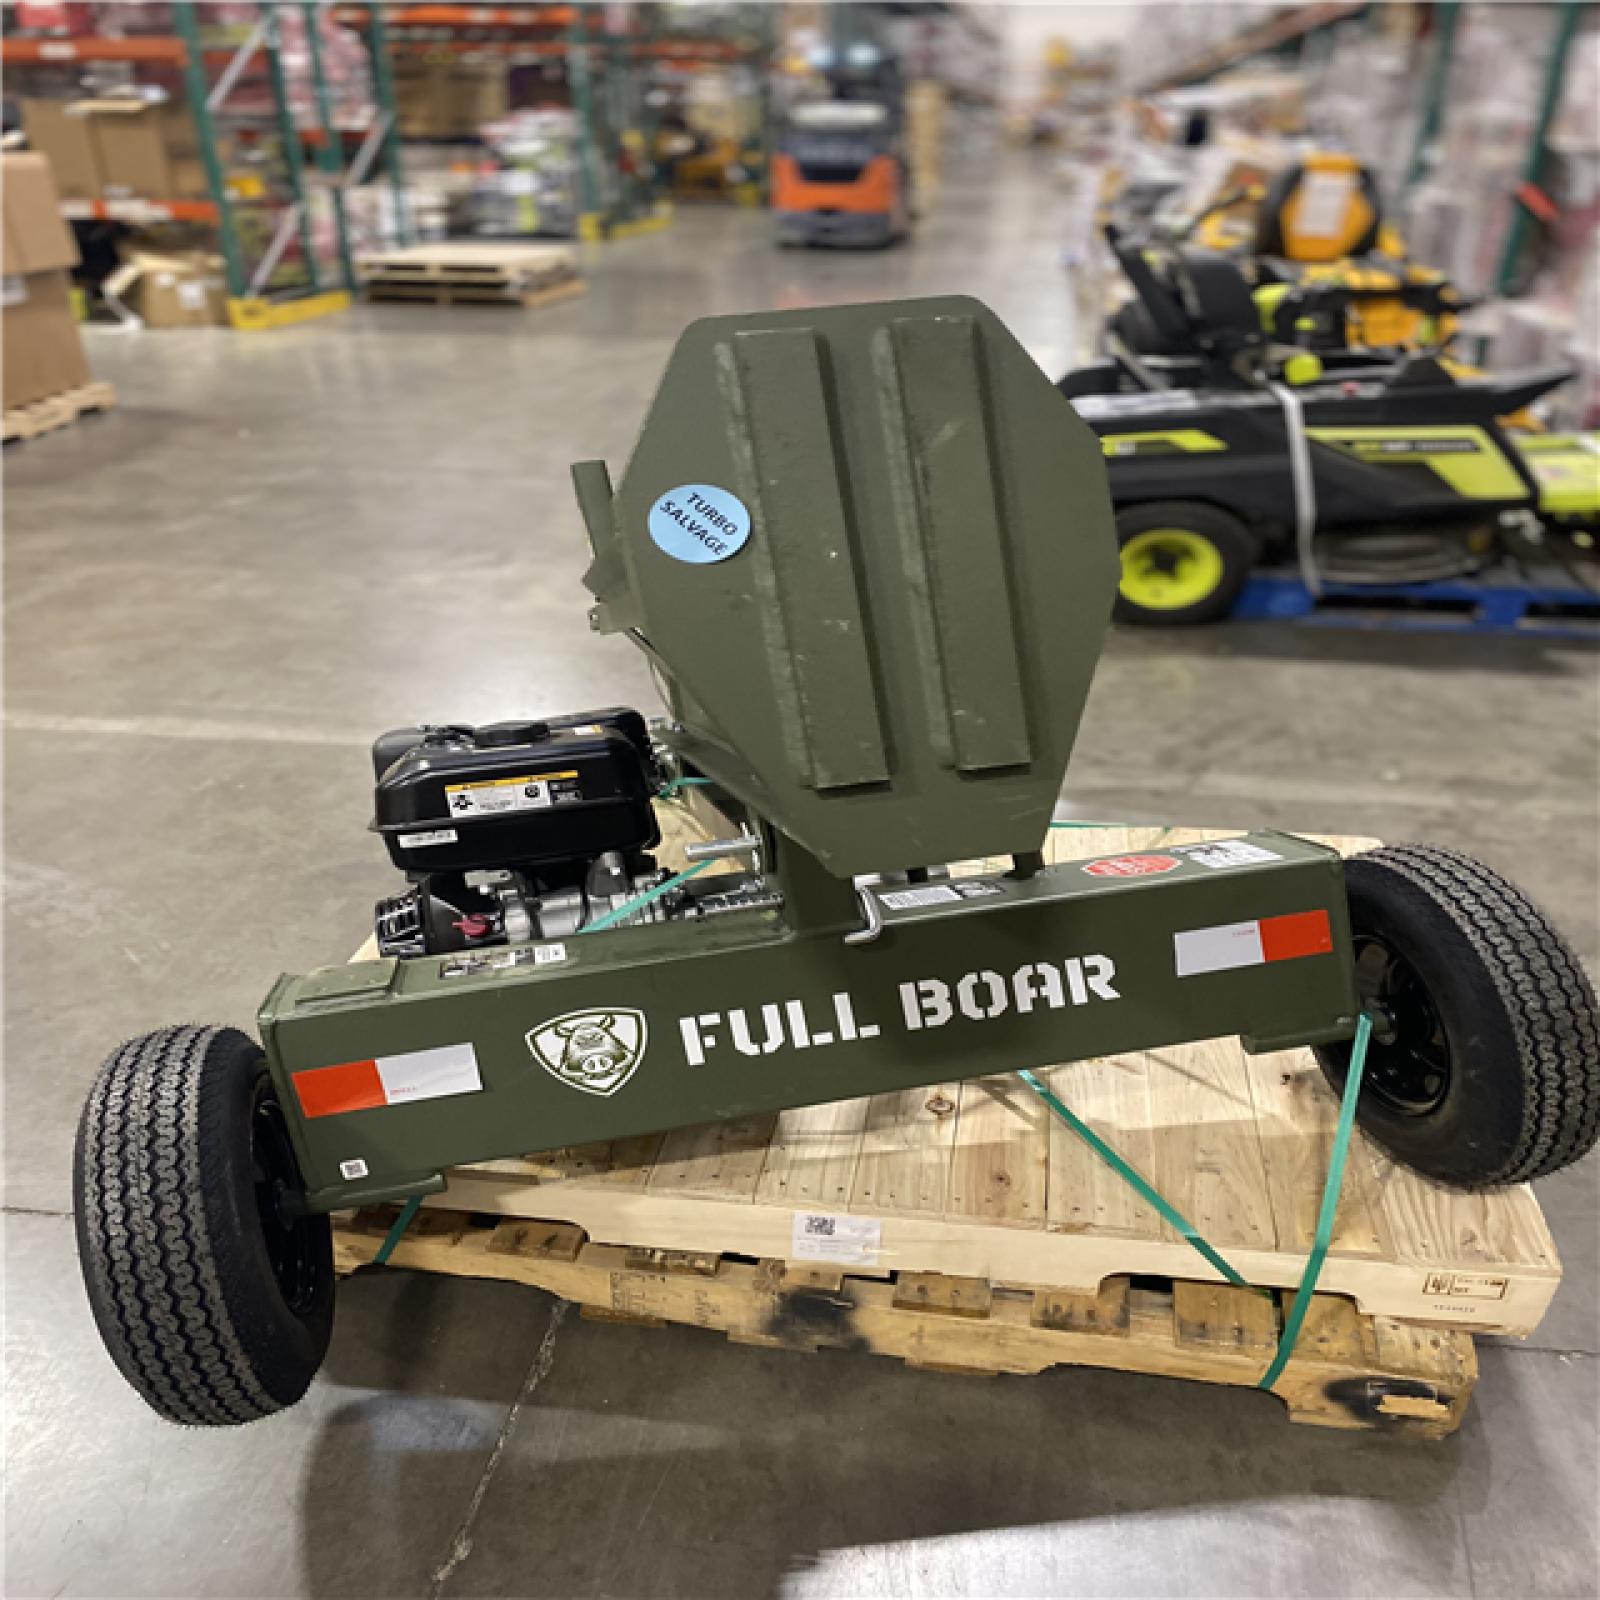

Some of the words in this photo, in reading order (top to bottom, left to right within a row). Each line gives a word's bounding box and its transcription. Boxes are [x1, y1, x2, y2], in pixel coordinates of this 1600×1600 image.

[660, 500, 728, 555] SALVAGE
[688, 492, 738, 535] TURBO
[679, 992, 881, 1066] FULL
[899, 954, 1121, 1030] BOAR
